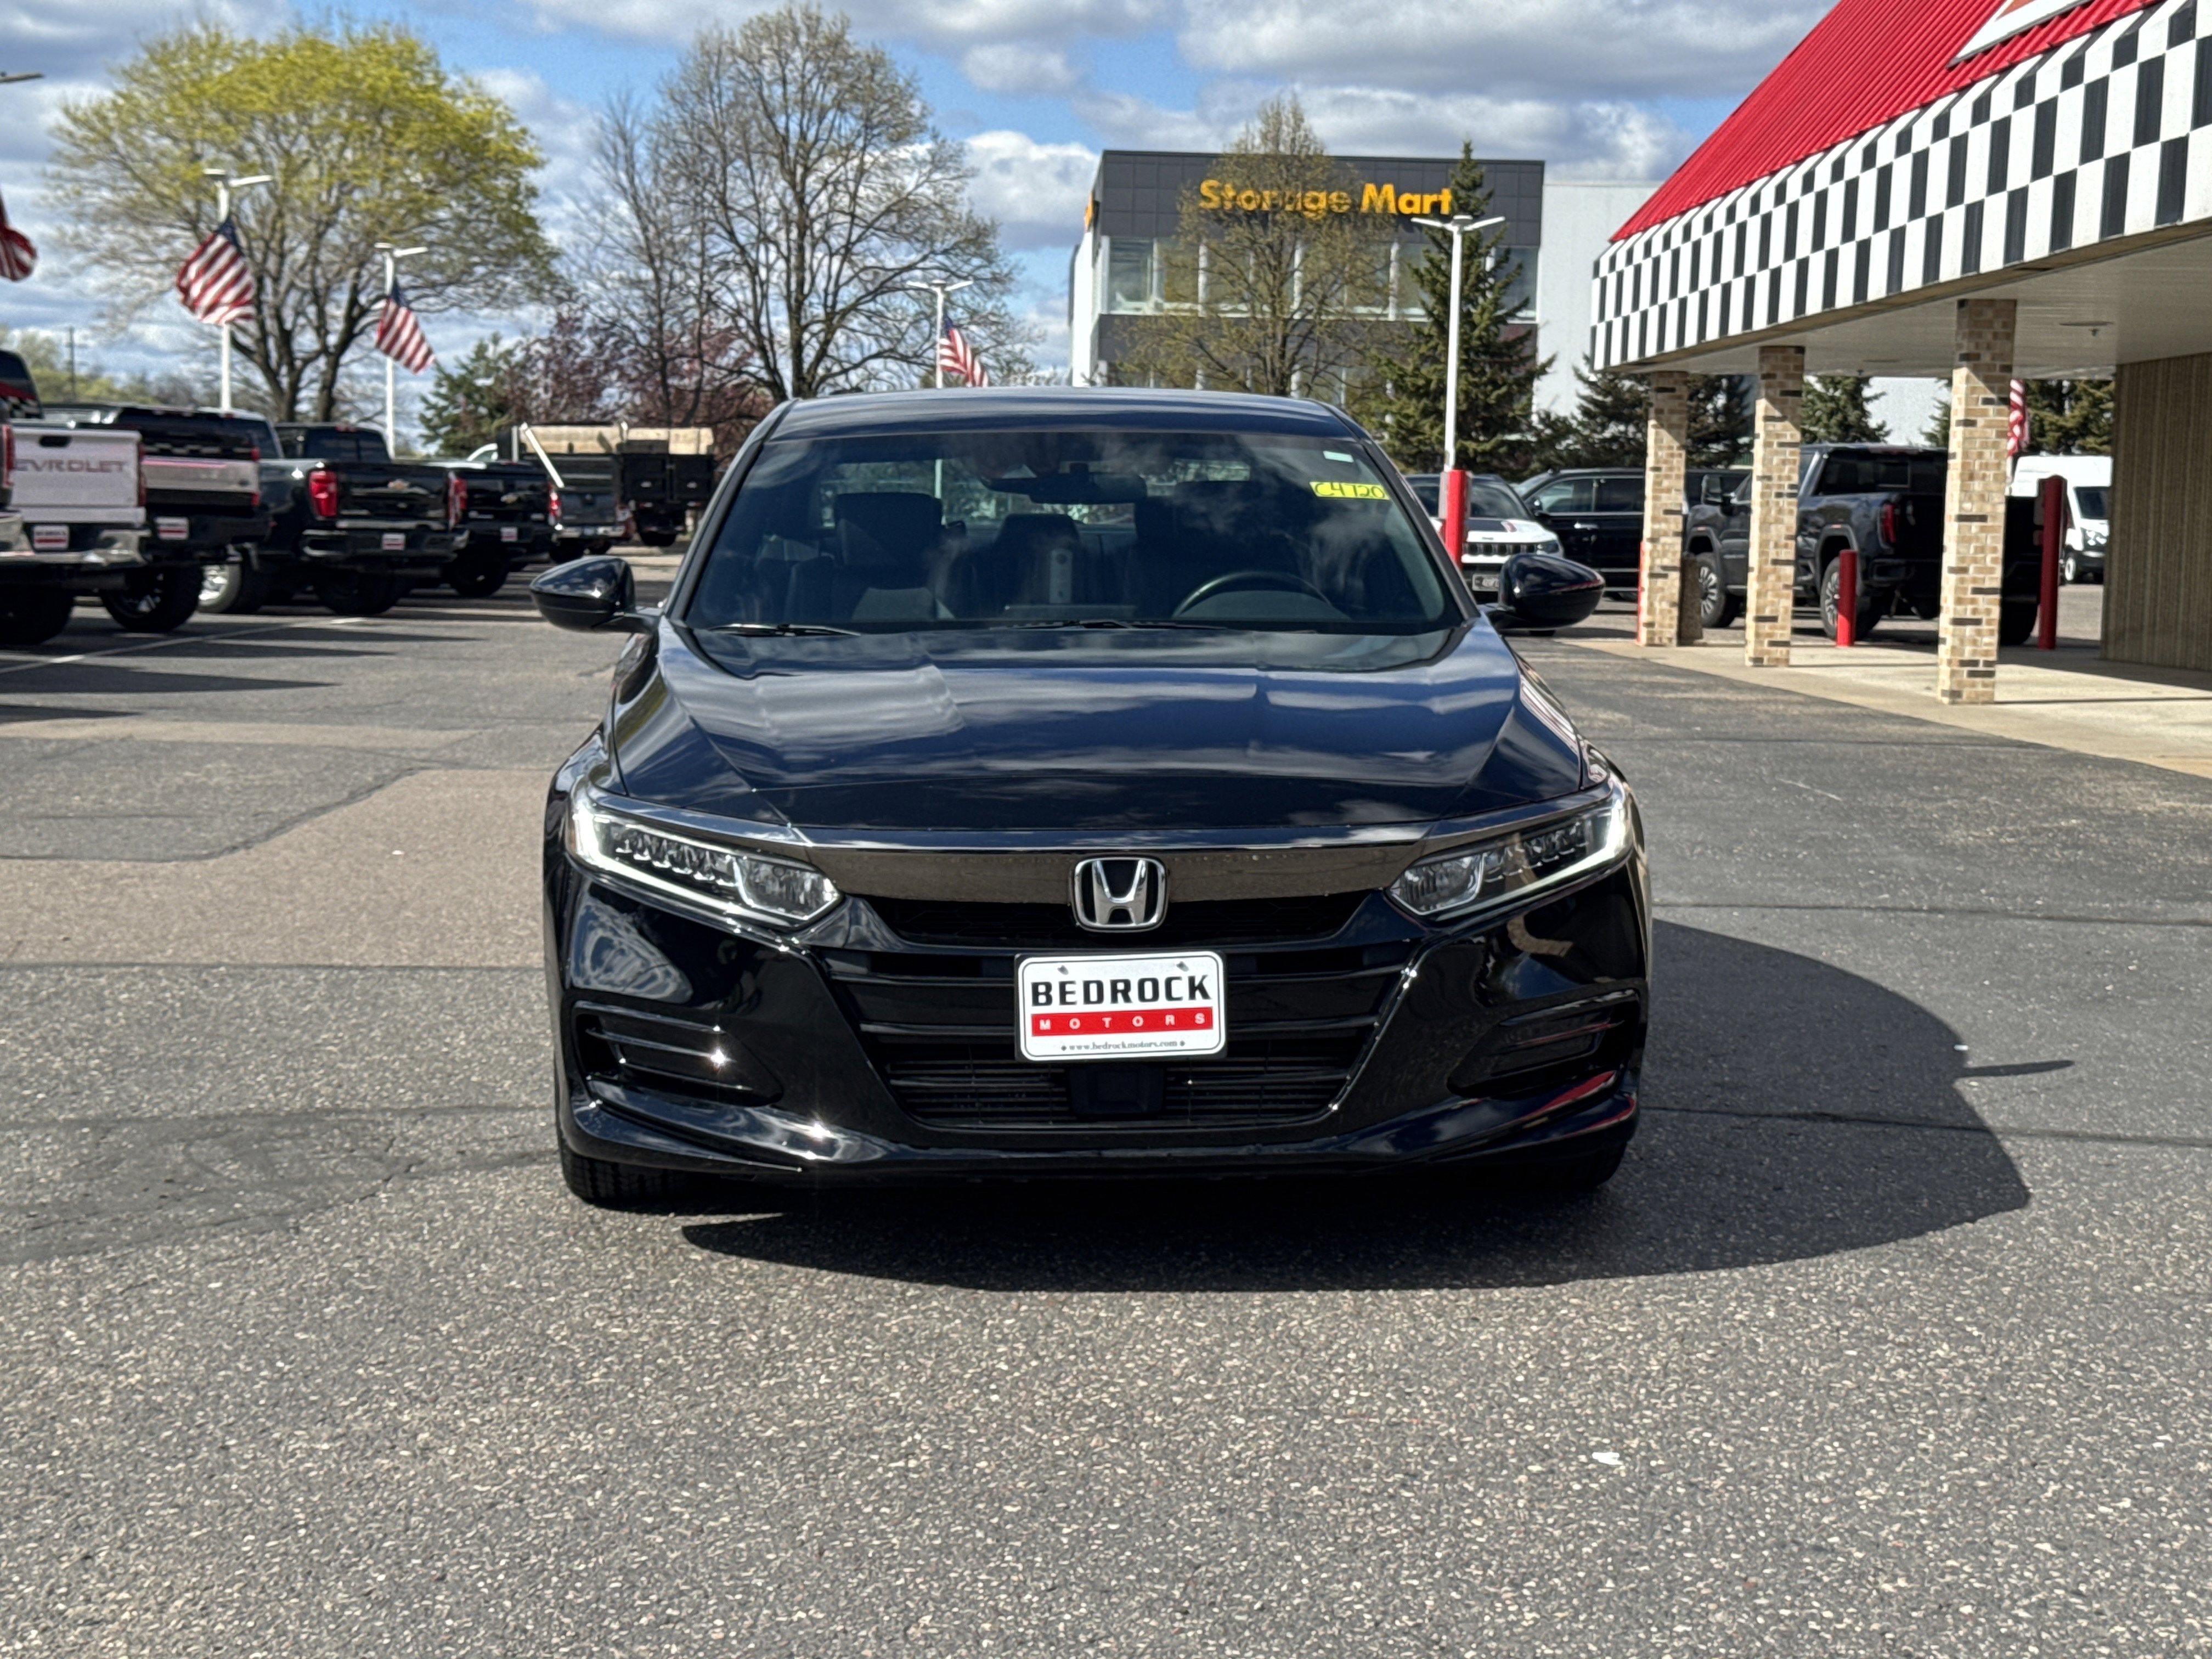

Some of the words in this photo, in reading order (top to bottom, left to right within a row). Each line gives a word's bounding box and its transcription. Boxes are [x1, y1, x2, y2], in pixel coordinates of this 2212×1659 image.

[1360, 182, 1452, 215] Mart
[15, 459, 125, 472] EVROLET
[1315, 482, 1385, 498] C4720
[1031, 974, 1212, 1007] BEDROCK
[1039, 1012, 1205, 1030] MOTORS
